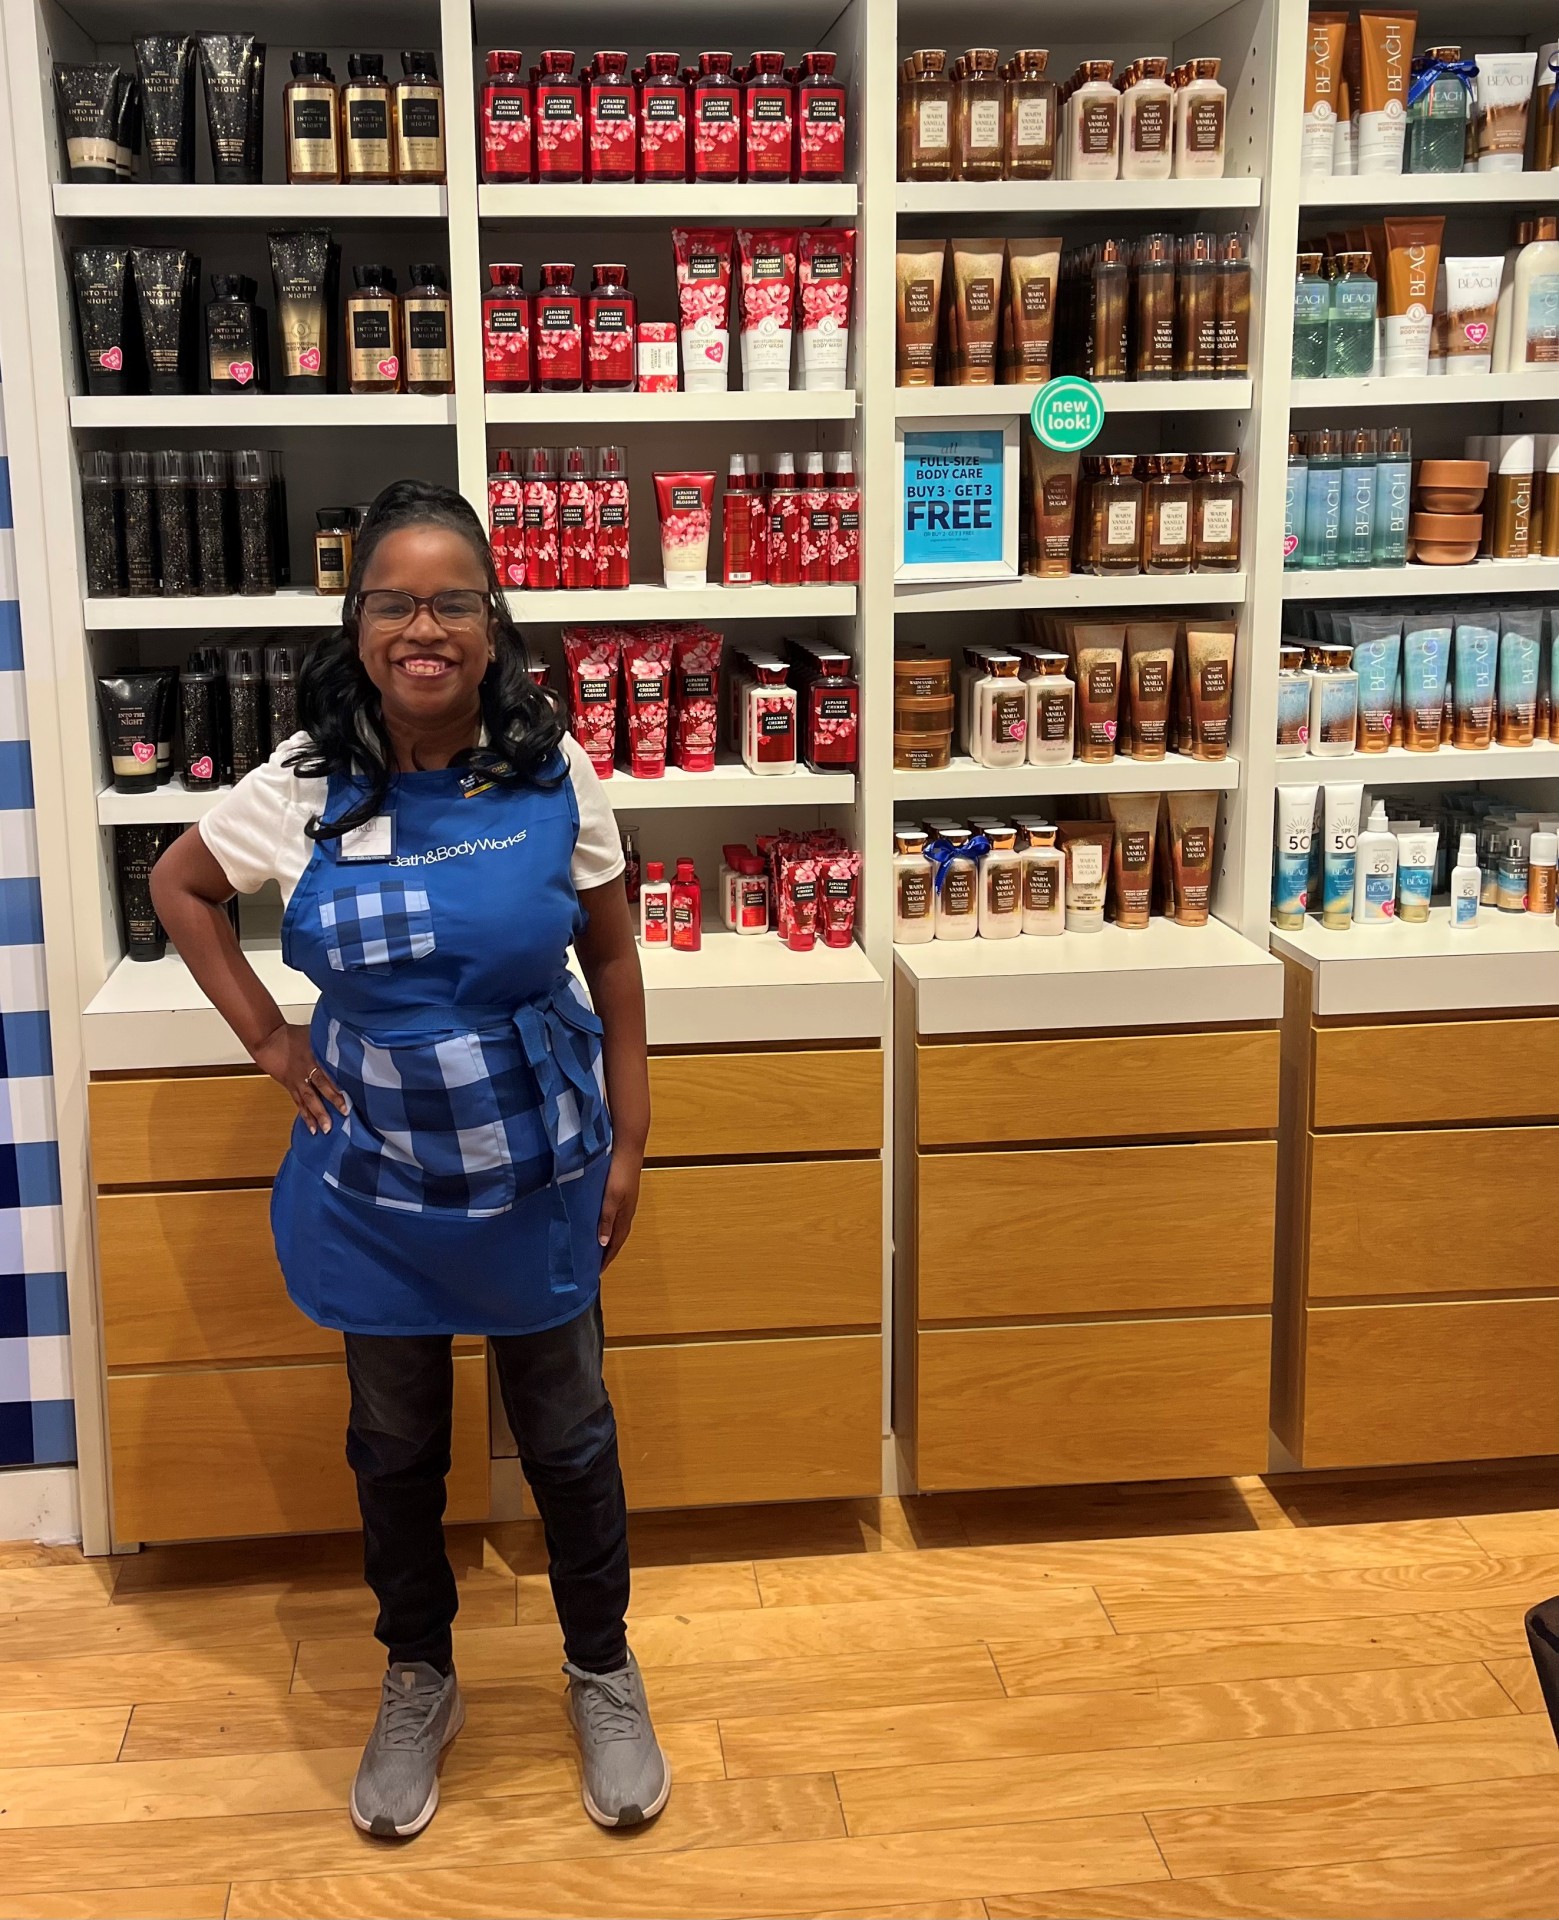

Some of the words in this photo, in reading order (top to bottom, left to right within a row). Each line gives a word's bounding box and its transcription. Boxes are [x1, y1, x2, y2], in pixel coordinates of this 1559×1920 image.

[1313, 28, 1331, 93] BEACH
[1386, 26, 1402, 91] BEACH
[1487, 76, 1529, 86] BEACH
[1458, 278, 1497, 289] BEACH
[1342, 294, 1375, 303] BEACH
[1052, 401, 1088, 413] new
[1048, 414, 1091, 430] look!
[920, 455, 980, 466] FULL-SIZE
[916, 469, 949, 480] BODY
[952, 468, 983, 479] CARE
[907, 486, 935, 498] BUY
[937, 485, 945, 497] 3
[955, 484, 982, 496] GET
[985, 484, 992, 496] 3
[907, 499, 992, 530] FREE
[1326, 481, 1339, 539] BEACH
[1355, 478, 1371, 536] BEACH
[1390, 474, 1406, 532] BEACH
[1515, 482, 1530, 541] BEACH
[1370, 641, 1385, 690] BEAC
[1422, 637, 1438, 689] BEAC
[1474, 636, 1489, 687] BEAC
[1521, 639, 1534, 684] BEAC
[1290, 836, 1310, 850] 50
[1335, 835, 1356, 849] 50
[1374, 864, 1389, 873] 50
